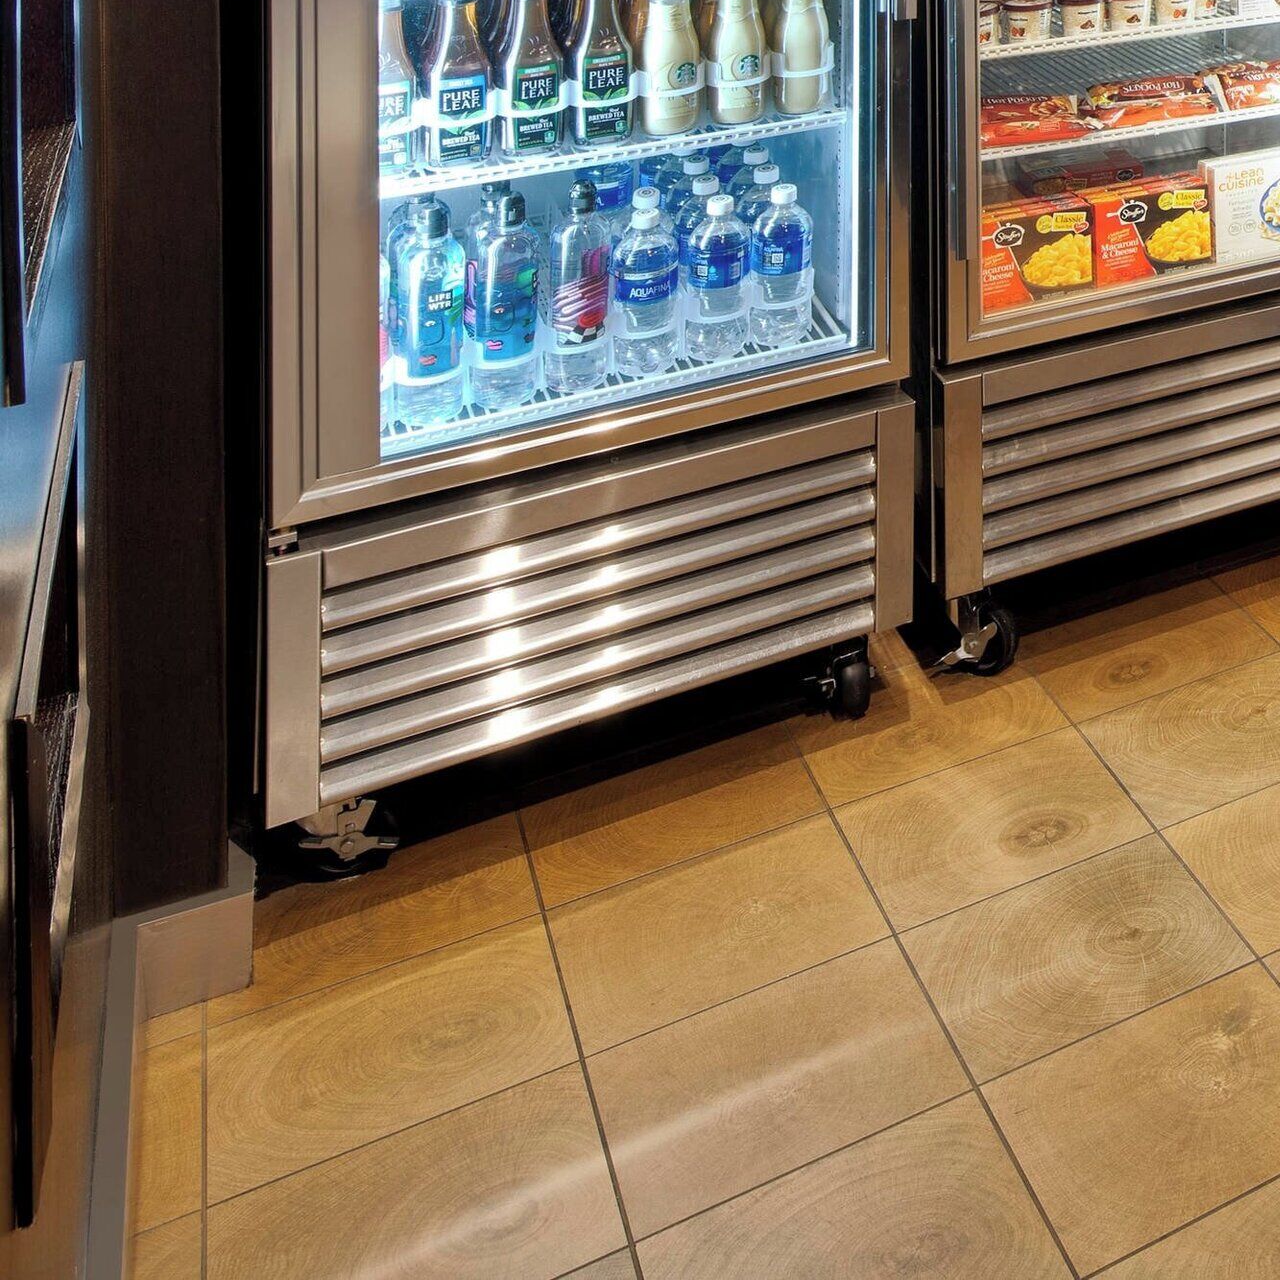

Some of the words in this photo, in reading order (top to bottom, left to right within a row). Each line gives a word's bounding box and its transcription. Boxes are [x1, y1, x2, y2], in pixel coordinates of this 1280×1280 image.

[589, 66, 624, 81] PURE
[521, 78, 553, 92] PURE
[442, 88, 480, 104] PURE
[1101, 240, 1139, 252] Macaroni
[1108, 246, 1138, 258] Cheese
[629, 281, 672, 299] AQUAFINA
[428, 292, 451, 303] LIFE
[428, 300, 452, 311] WTR
